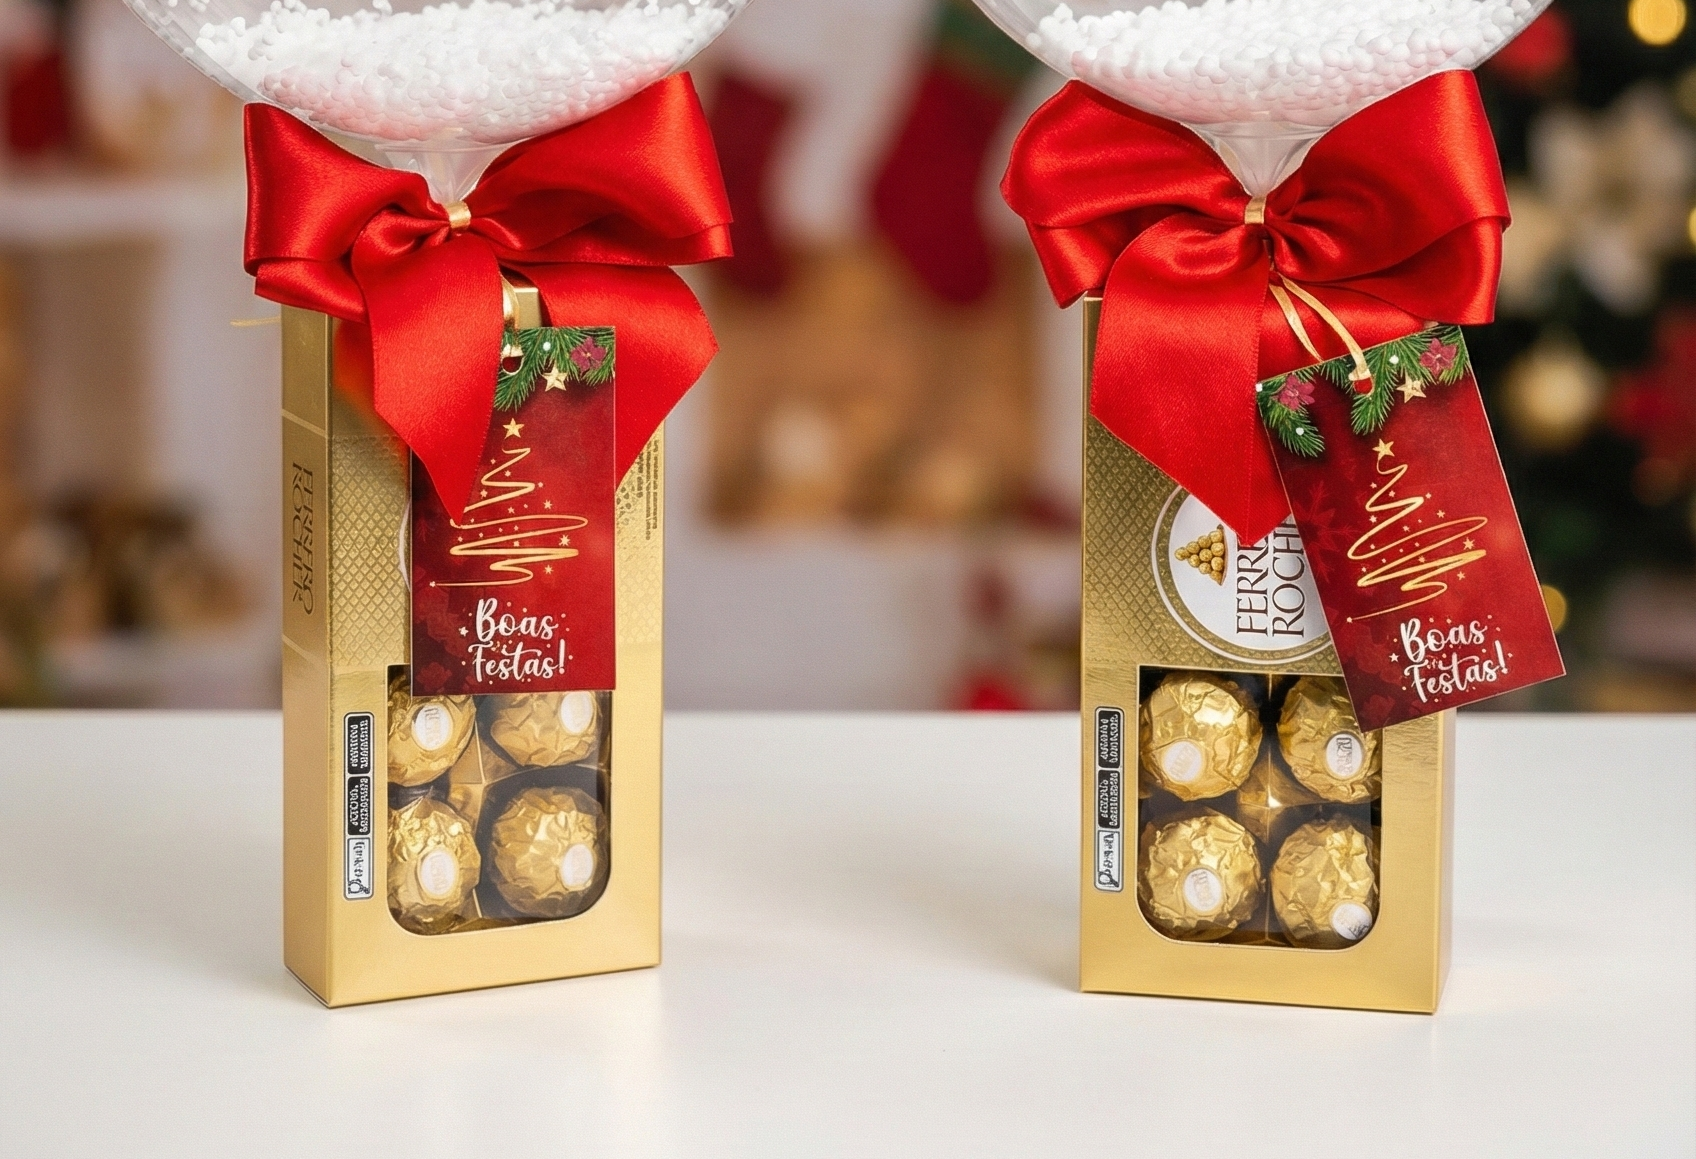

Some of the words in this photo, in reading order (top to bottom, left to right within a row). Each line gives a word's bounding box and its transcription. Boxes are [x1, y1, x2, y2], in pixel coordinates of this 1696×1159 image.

[475, 597, 559, 642] Boas
[1400, 617, 1488, 662] Boas
[467, 638, 566, 683] Festas!
[1403, 639, 1509, 703] Festas!
